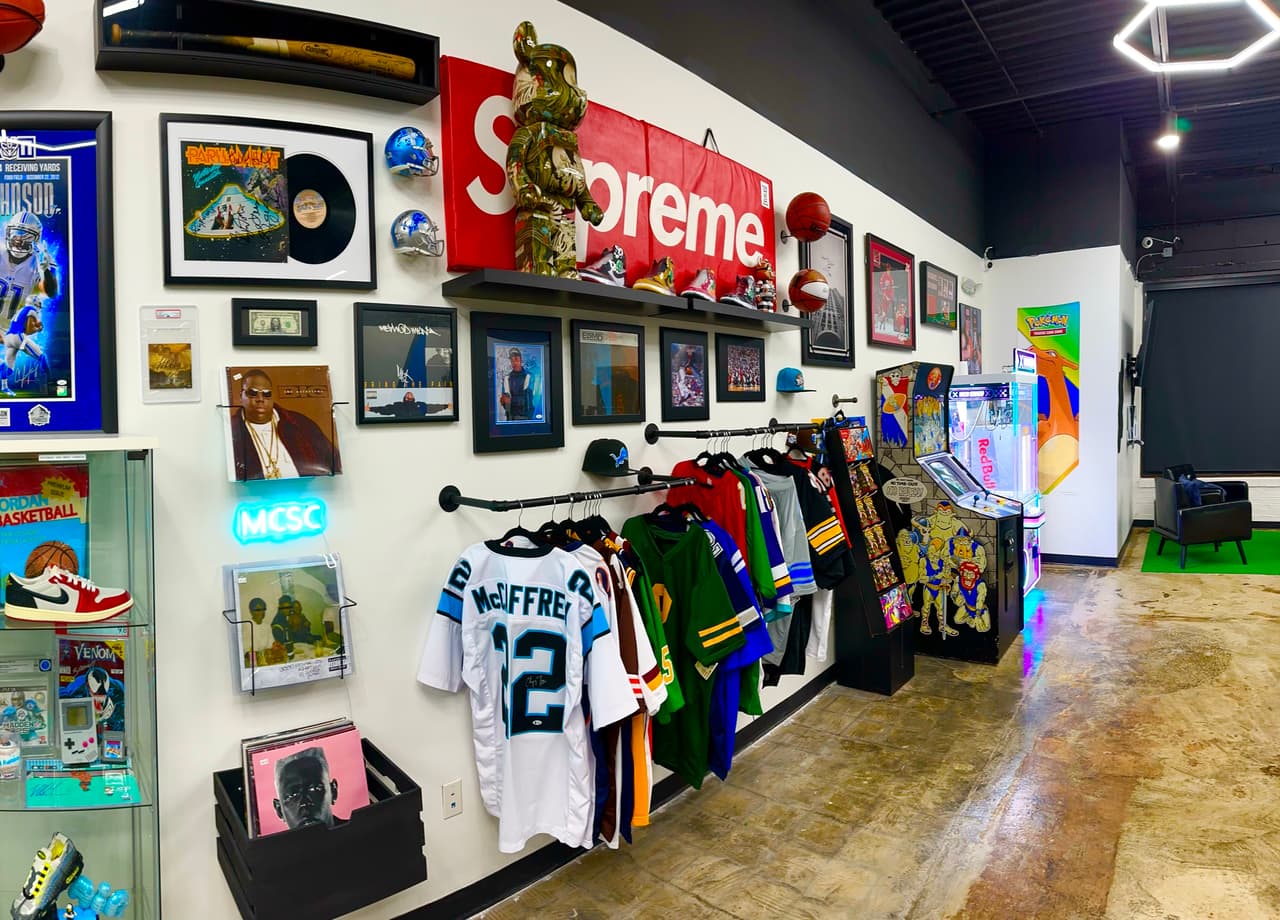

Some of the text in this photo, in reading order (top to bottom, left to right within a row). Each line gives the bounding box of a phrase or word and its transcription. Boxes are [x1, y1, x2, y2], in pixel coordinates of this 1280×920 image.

[5, 162, 38, 172] RECEIVING
[39, 162, 60, 172] YARDS
[466, 95, 765, 268] Spreme
[241, 504, 321, 536] MCSC
[74, 642, 116, 662] VENOM
